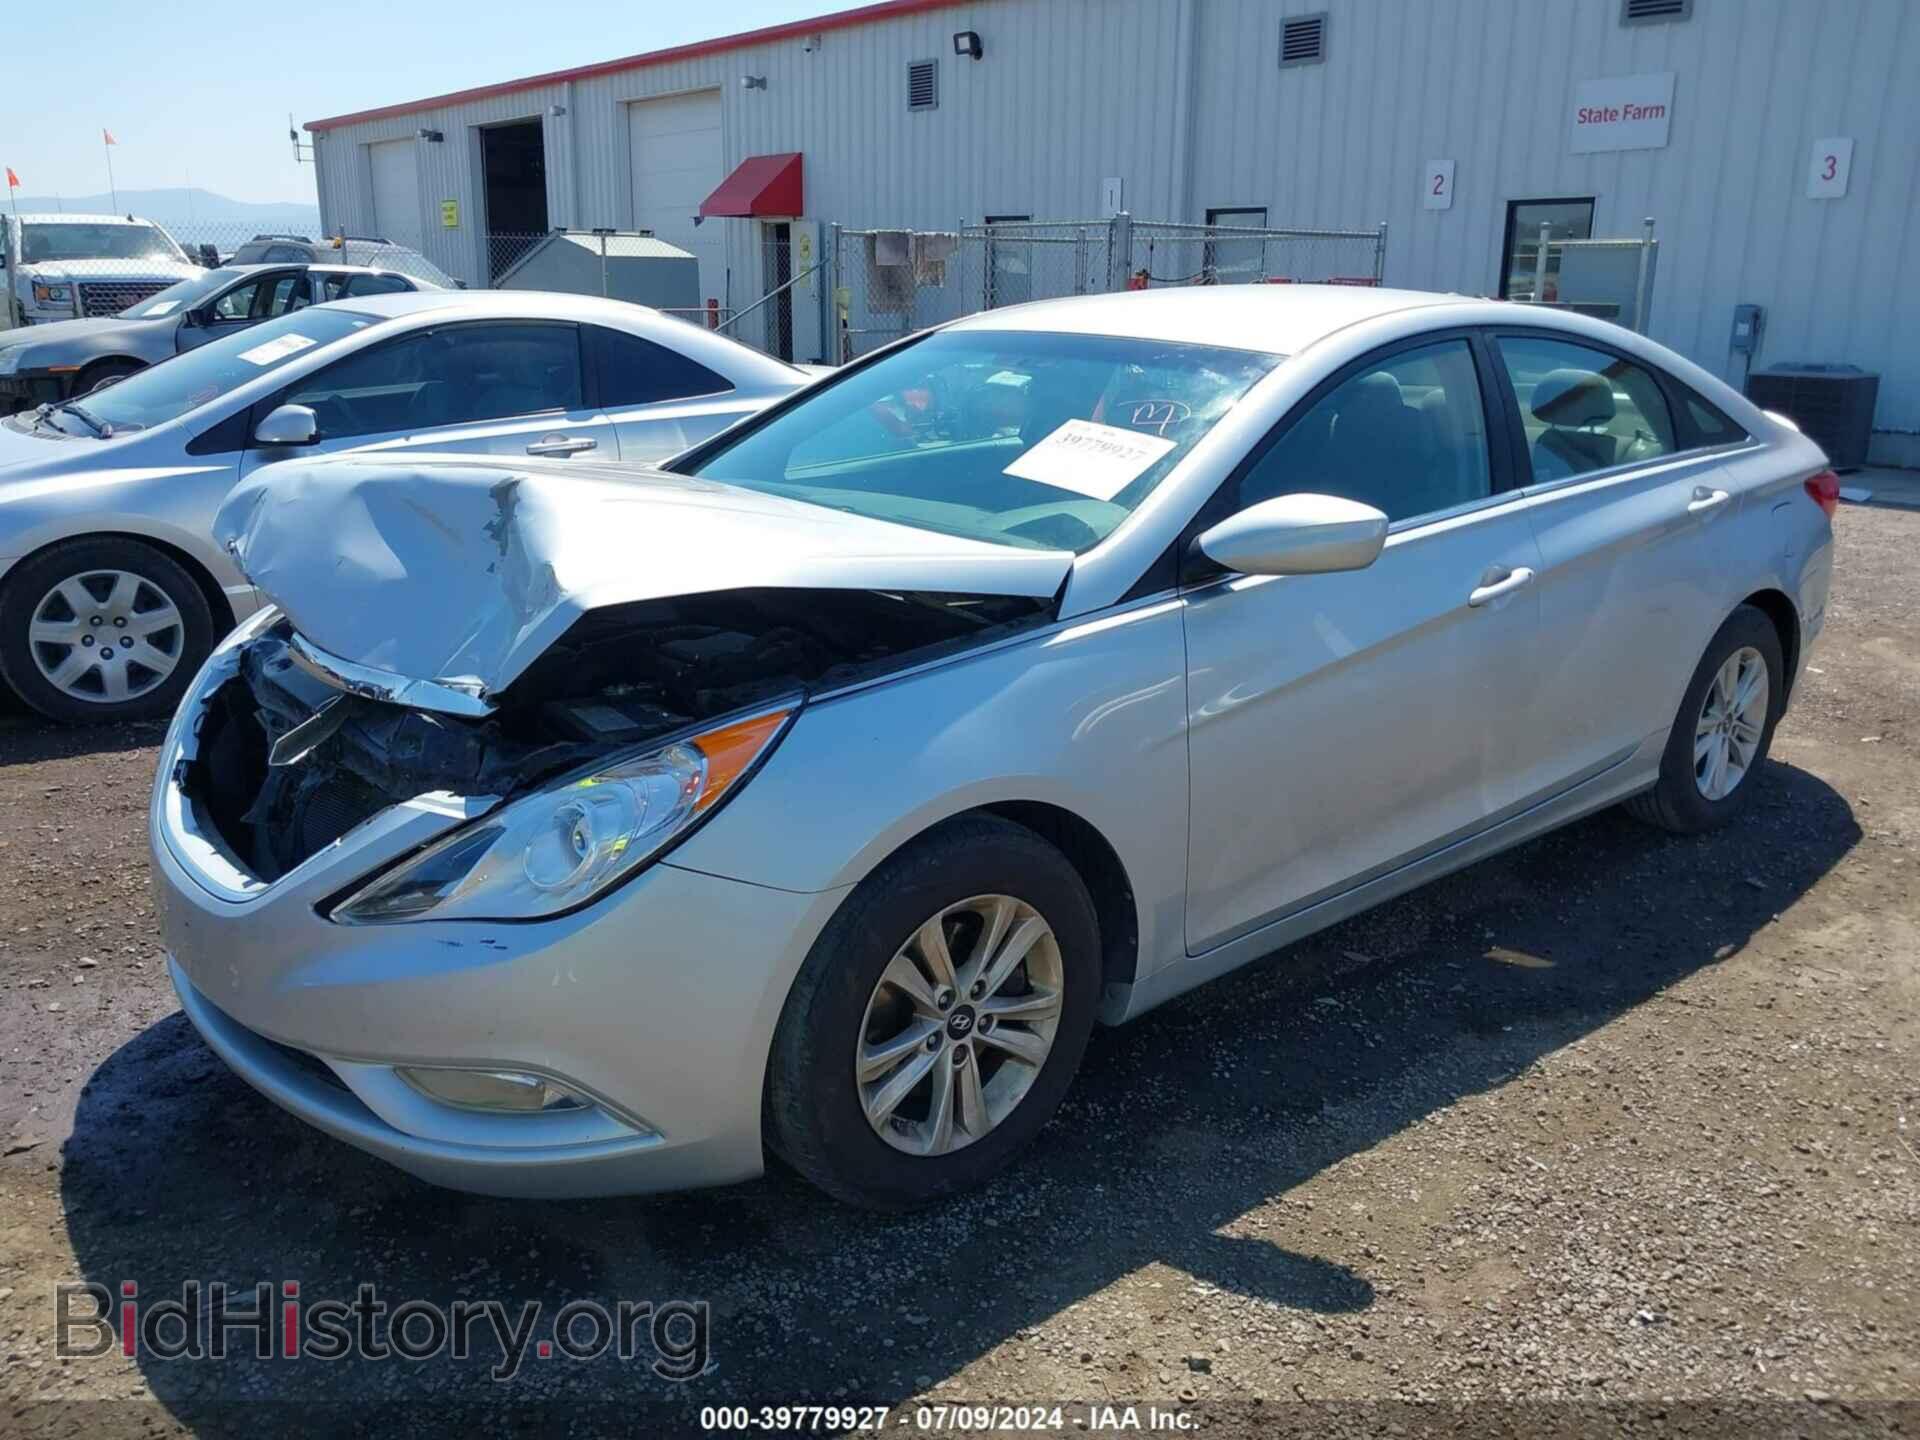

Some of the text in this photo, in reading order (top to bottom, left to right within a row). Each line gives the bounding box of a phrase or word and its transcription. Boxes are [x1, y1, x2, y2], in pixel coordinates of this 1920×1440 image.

[1577, 103, 1665, 124] State Farm
[1821, 155, 1837, 181] 3
[1432, 174, 1445, 196] 2
